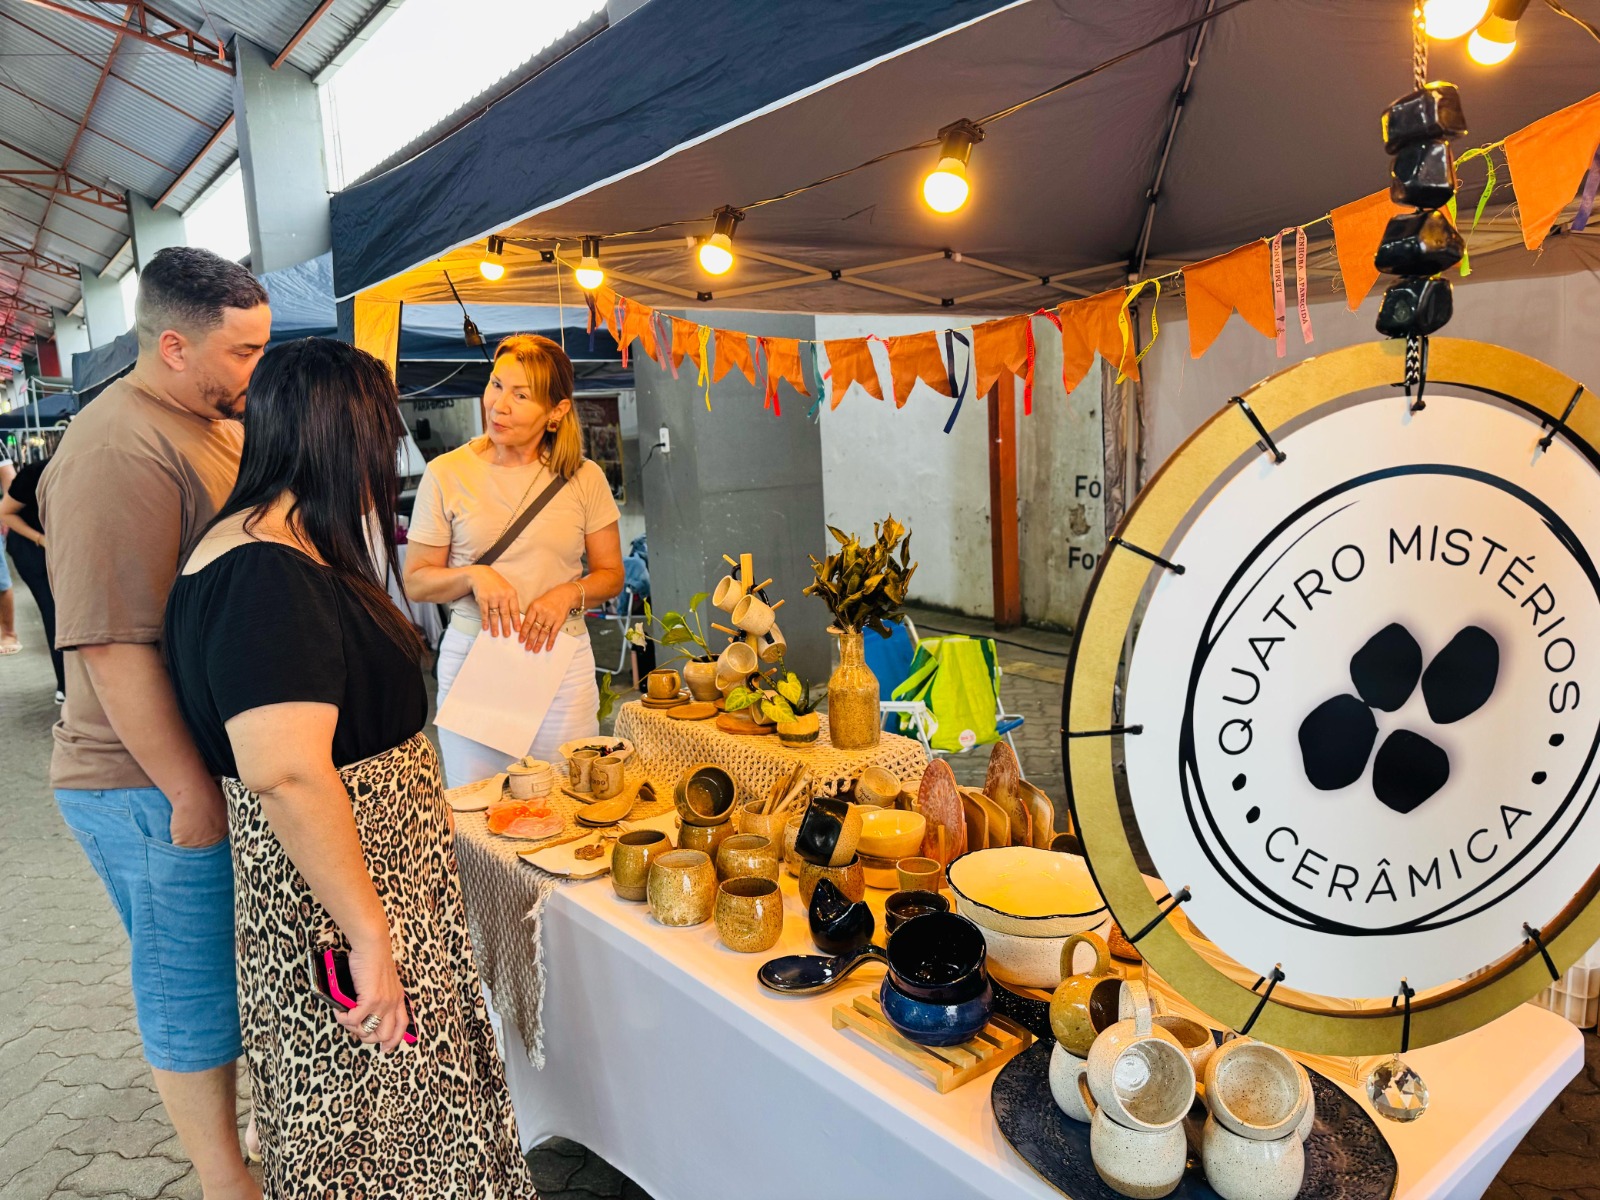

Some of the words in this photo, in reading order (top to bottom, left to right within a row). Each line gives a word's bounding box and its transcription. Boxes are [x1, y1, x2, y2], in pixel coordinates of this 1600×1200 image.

[1274, 239, 1283, 293] LEMBRANÇA
[1298, 276, 1310, 325] APARECIDA
[1218, 544, 1365, 755] QUATRO
[1388, 525, 1580, 713] MISTÉRIOS
[1265, 804, 1532, 903] CERÂMICA
